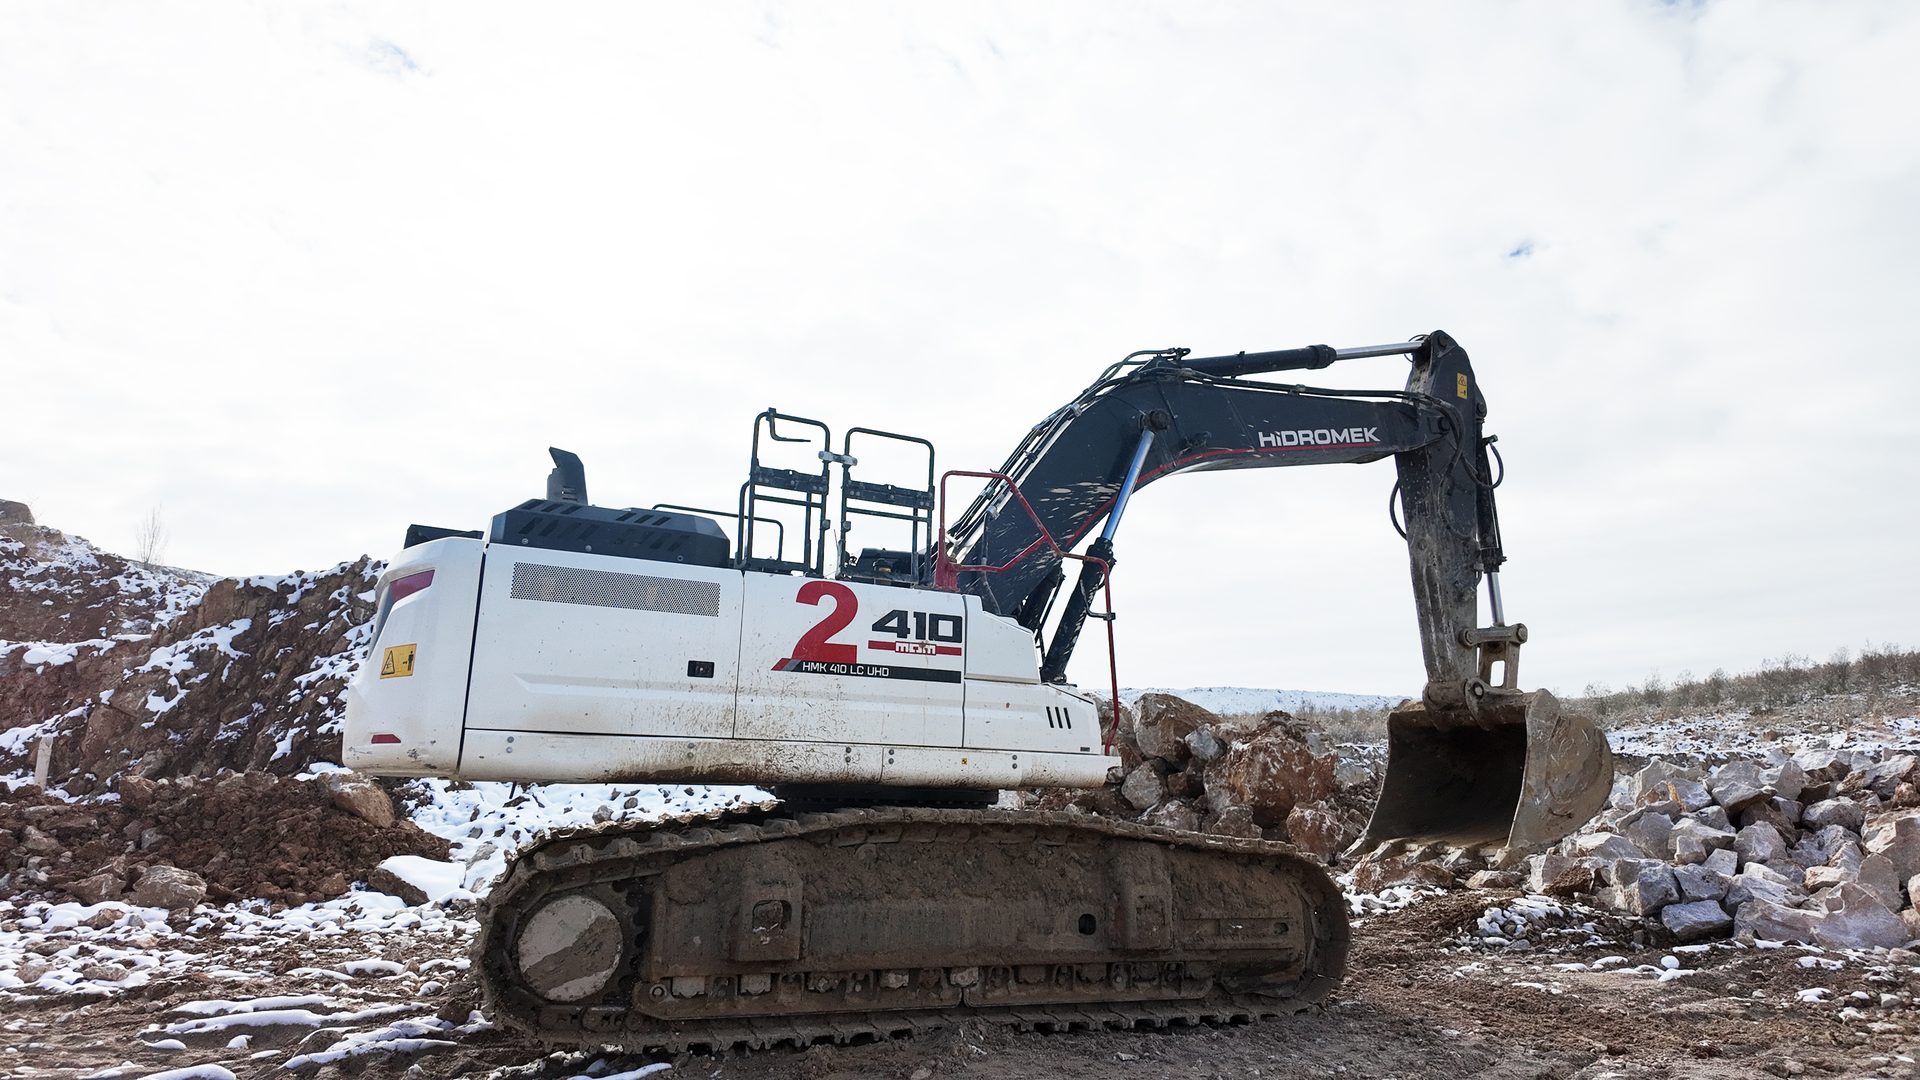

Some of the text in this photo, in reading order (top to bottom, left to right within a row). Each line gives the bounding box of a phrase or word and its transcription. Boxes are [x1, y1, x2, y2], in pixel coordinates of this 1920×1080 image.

[792, 580, 858, 664] 2
[871, 609, 963, 643] 410
[802, 661, 890, 677] HMK 410 LC UHD
